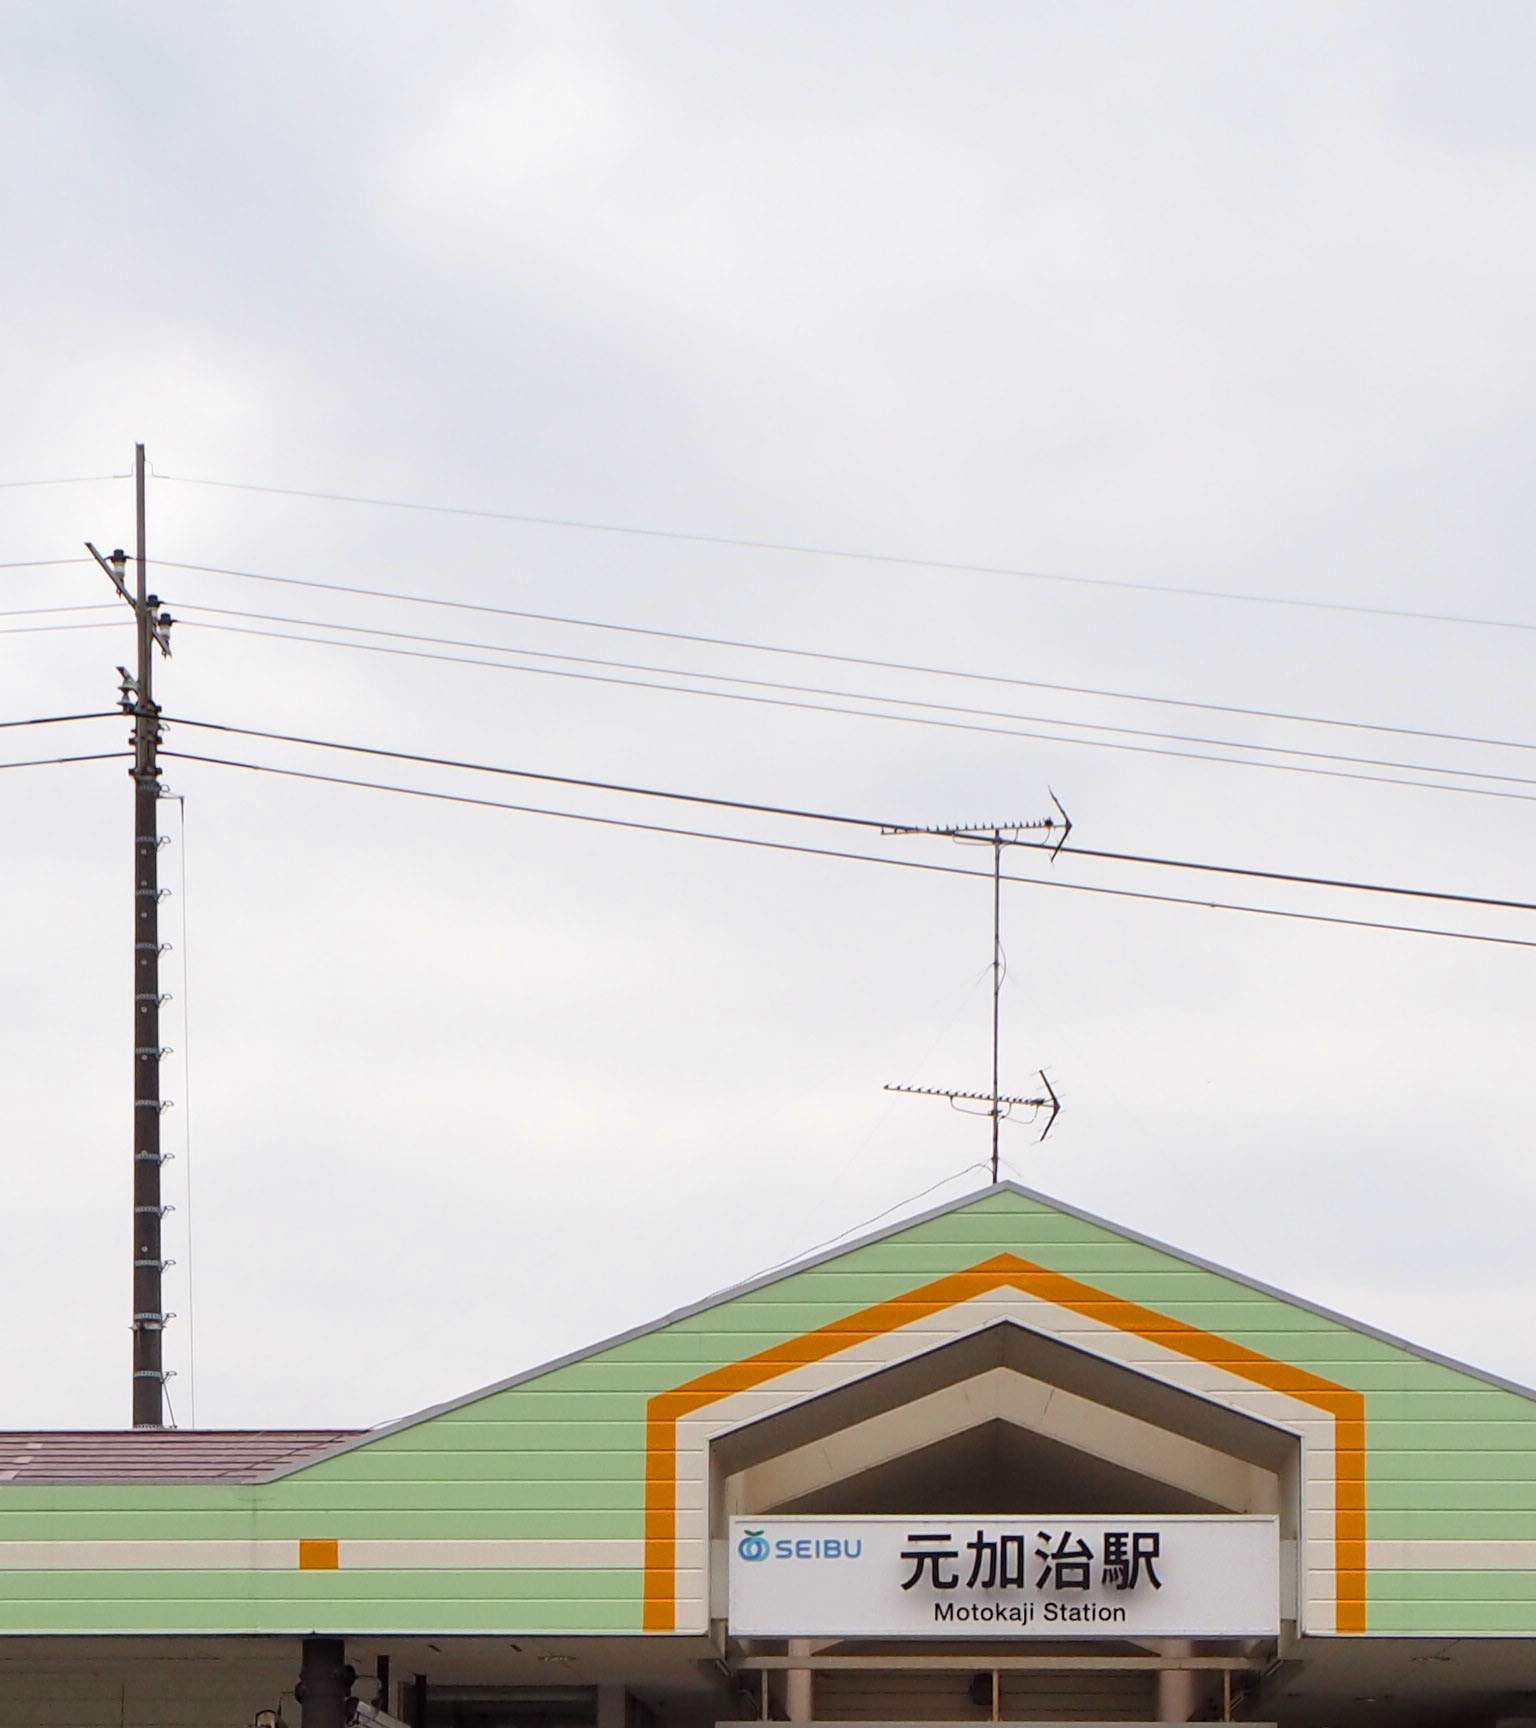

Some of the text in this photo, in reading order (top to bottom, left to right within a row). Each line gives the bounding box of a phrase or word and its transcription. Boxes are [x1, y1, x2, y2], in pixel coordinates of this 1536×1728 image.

[775, 1538, 862, 1560] SEIBU
[899, 1530, 1163, 1591] 元加治駅
[933, 1602, 1127, 1626] Motokaji Station
